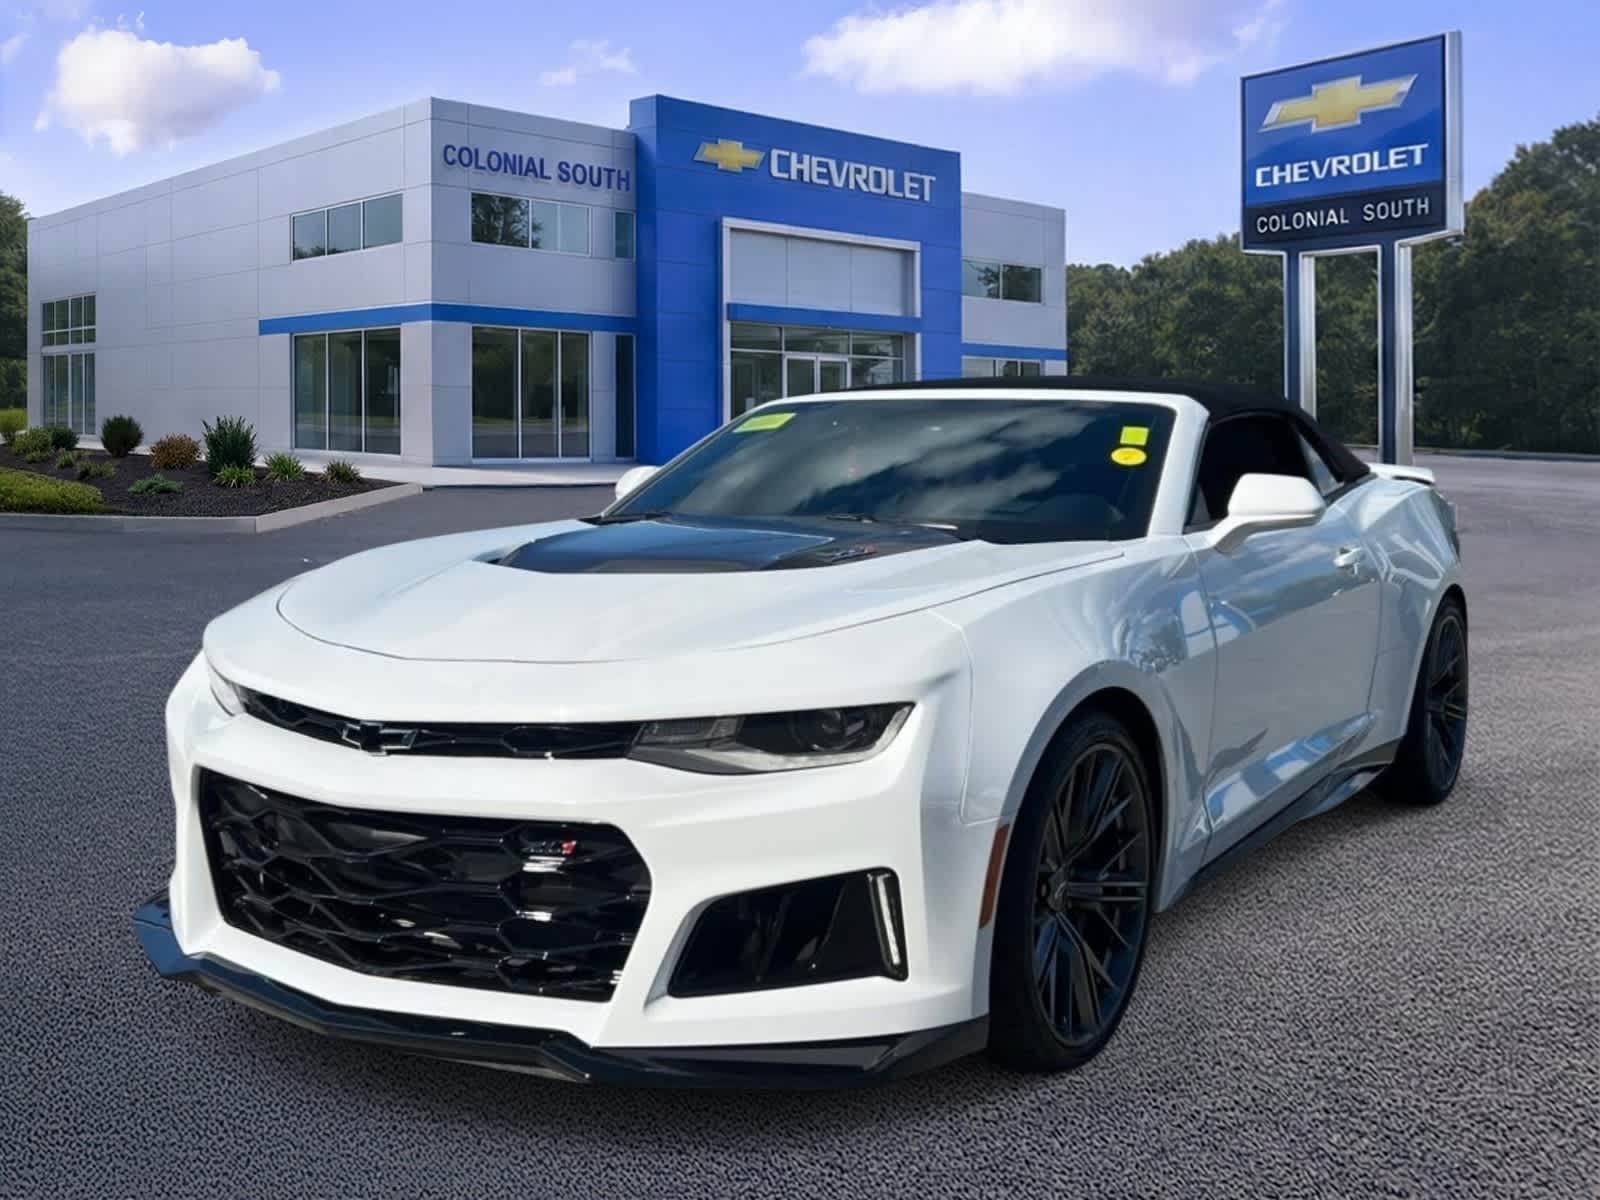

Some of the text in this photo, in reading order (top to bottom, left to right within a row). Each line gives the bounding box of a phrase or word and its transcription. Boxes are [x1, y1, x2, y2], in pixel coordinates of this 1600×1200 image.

[442, 144, 631, 192] COLONIAL SOUTH
[770, 148, 936, 201] CHEVROLET
[1255, 143, 1428, 187] CHEVROLET
[1256, 197, 1430, 233] COLONIAL SOUTH
